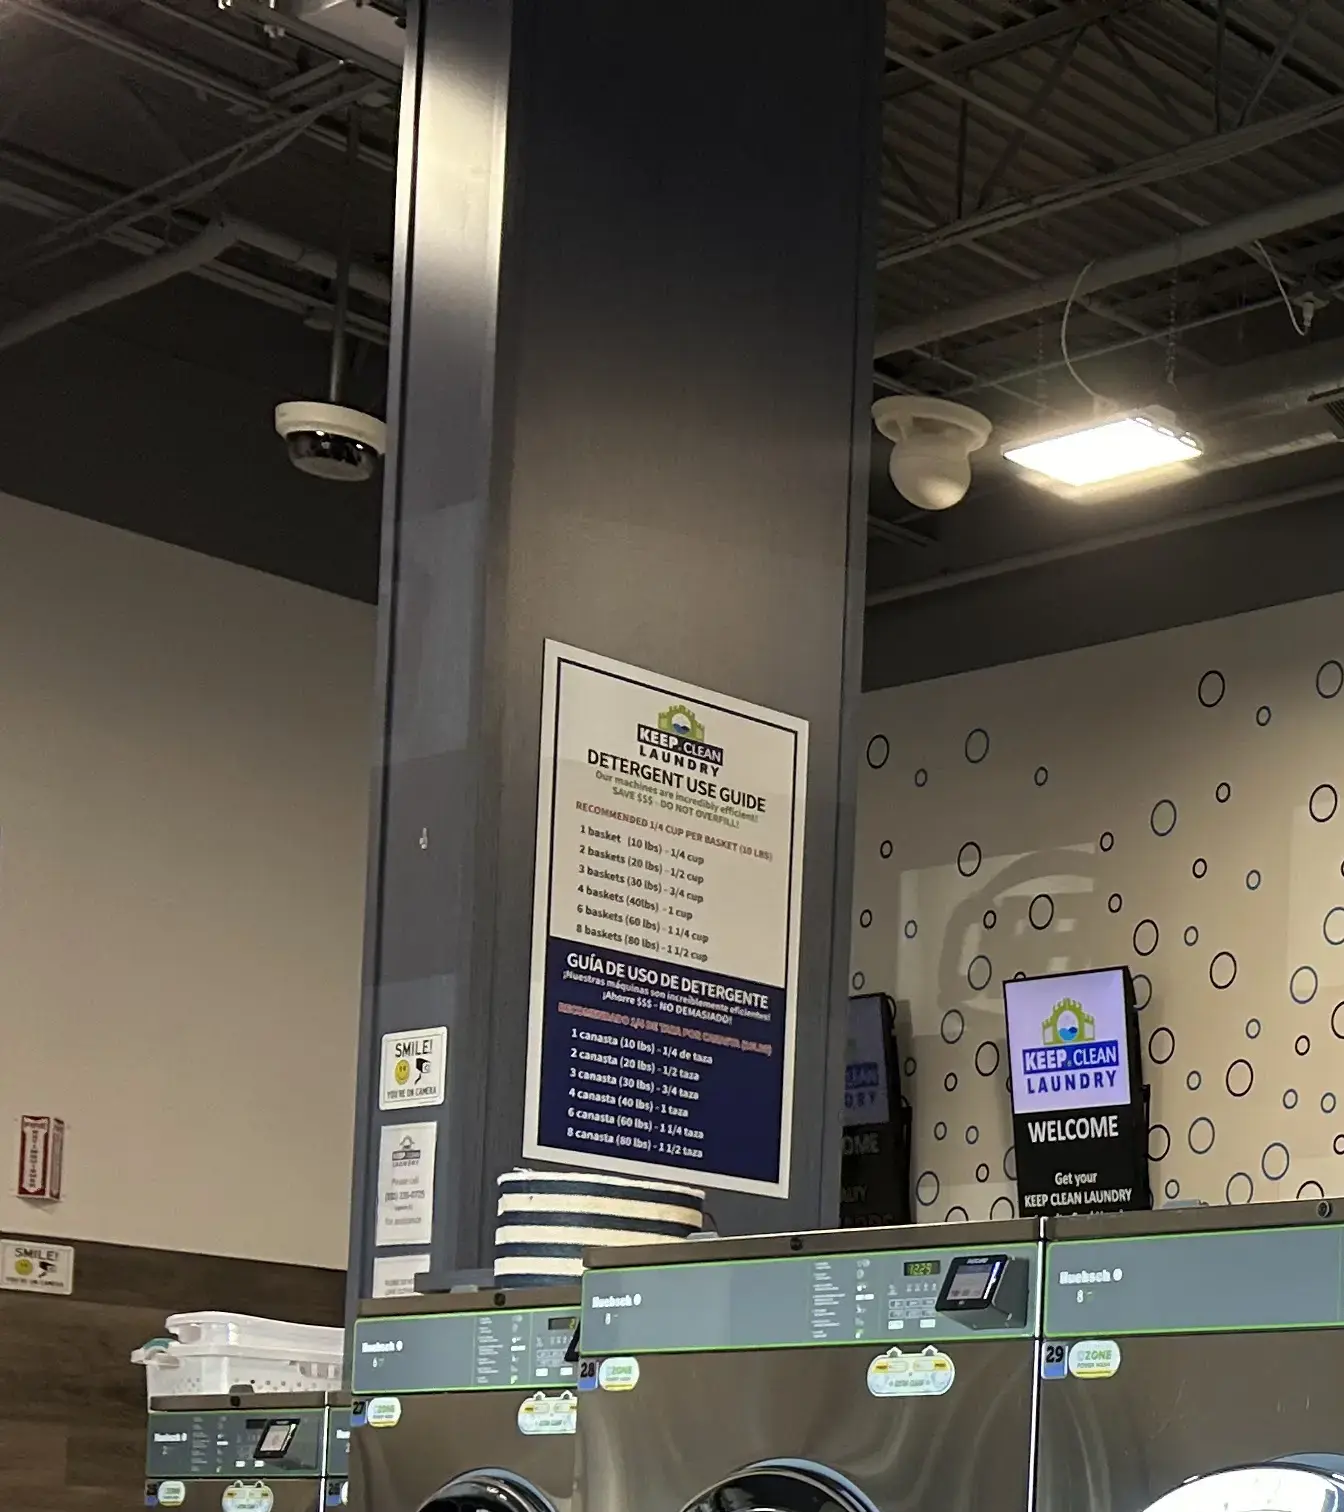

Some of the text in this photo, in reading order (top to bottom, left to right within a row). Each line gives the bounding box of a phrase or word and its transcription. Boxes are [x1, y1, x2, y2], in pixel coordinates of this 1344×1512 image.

[639, 727, 721, 763] KEEP CLEAN
[639, 744, 719, 778] LAUNDRY
[587, 748, 766, 812] DETERGENT USE GUIDE
[595, 769, 612, 782] Our
[614, 775, 657, 795] machines
[659, 789, 674, 799] are
[612, 785, 634, 800] SAVE
[660, 799, 673, 811] DO
[675, 803, 693, 816] NOT
[575, 800, 647, 827] RECOMMENDED
[650, 820, 663, 832] 1/4
[664, 824, 683, 837] CUP
[684, 829, 702, 842] PER
[704, 834, 737, 851] BASKET
[580, 824, 704, 866] 1 basket (10 lbs) 1/4 cup
[579, 844, 704, 886] 2 baskets (20 lbs) 1/2 cup
[578, 864, 703, 905] 3 baskets (30 lbs) 3/4 cup
[577, 883, 583, 893] 4
[586, 885, 624, 903] baskets
[668, 905, 673, 915] 1
[675, 909, 692, 921] cup
[576, 903, 583, 913] 6
[585, 905, 623, 922] baskets
[625, 914, 640, 928] (60
[642, 918, 660, 933] lbs)
[675, 926, 689, 939] 1/4
[691, 932, 708, 944] cup
[575, 923, 582, 933] 8
[584, 924, 622, 942] baskets
[624, 933, 640, 948] (80
[641, 937, 659, 952] lbs)
[674, 946, 688, 959] 1/2
[690, 951, 708, 963] cup
[567, 953, 768, 1010] GUÍA DE USO DE DETERGENTE
[649, 989, 665, 998] son
[636, 996, 652, 1009] $$$
[659, 1001, 674, 1013] NO
[394, 1038, 433, 1058] SMILE!
[571, 1028, 712, 1064] 1 canasta (10 lbs) 1/4 de taza
[1024, 1046, 1117, 1071] KEEP CLEAN
[570, 1048, 699, 1081] 2 canasta (20 lbs) 1/2 taza
[387, 1089, 406, 1099] YOU'RE
[414, 1086, 437, 1096] CAMERA
[569, 1067, 699, 1100] 3 canasta (30 lbs) 3/4 taza
[1026, 1070, 1117, 1094] LAUNDRY
[568, 1087, 688, 1117] 4 canasta (40 lbs) 1 taza
[567, 1107, 574, 1117] 6
[575, 1108, 615, 1124] canasta
[616, 1114, 632, 1128] (60
[633, 1117, 652, 1132] lbs)
[667, 1124, 682, 1137] 1/4
[683, 1127, 704, 1139] taza
[1027, 1115, 1119, 1144] WELCOME
[566, 1127, 573, 1136] 8
[574, 1128, 614, 1143] canasta
[615, 1134, 631, 1148] (80
[633, 1137, 651, 1151] lbs)
[666, 1143, 681, 1156] 1/2
[682, 1146, 702, 1158] taza
[1054, 1171, 1098, 1187] Get your
[1024, 1188, 1133, 1208] KEEP CLEAN LAUNDRY
[15, 1247, 59, 1261] SMILE!
[1059, 1269, 1111, 1284] Huebsch
[580, 1362, 595, 1377] 28
[1045, 1345, 1064, 1363] 29
[353, 1401, 365, 1415] 27
